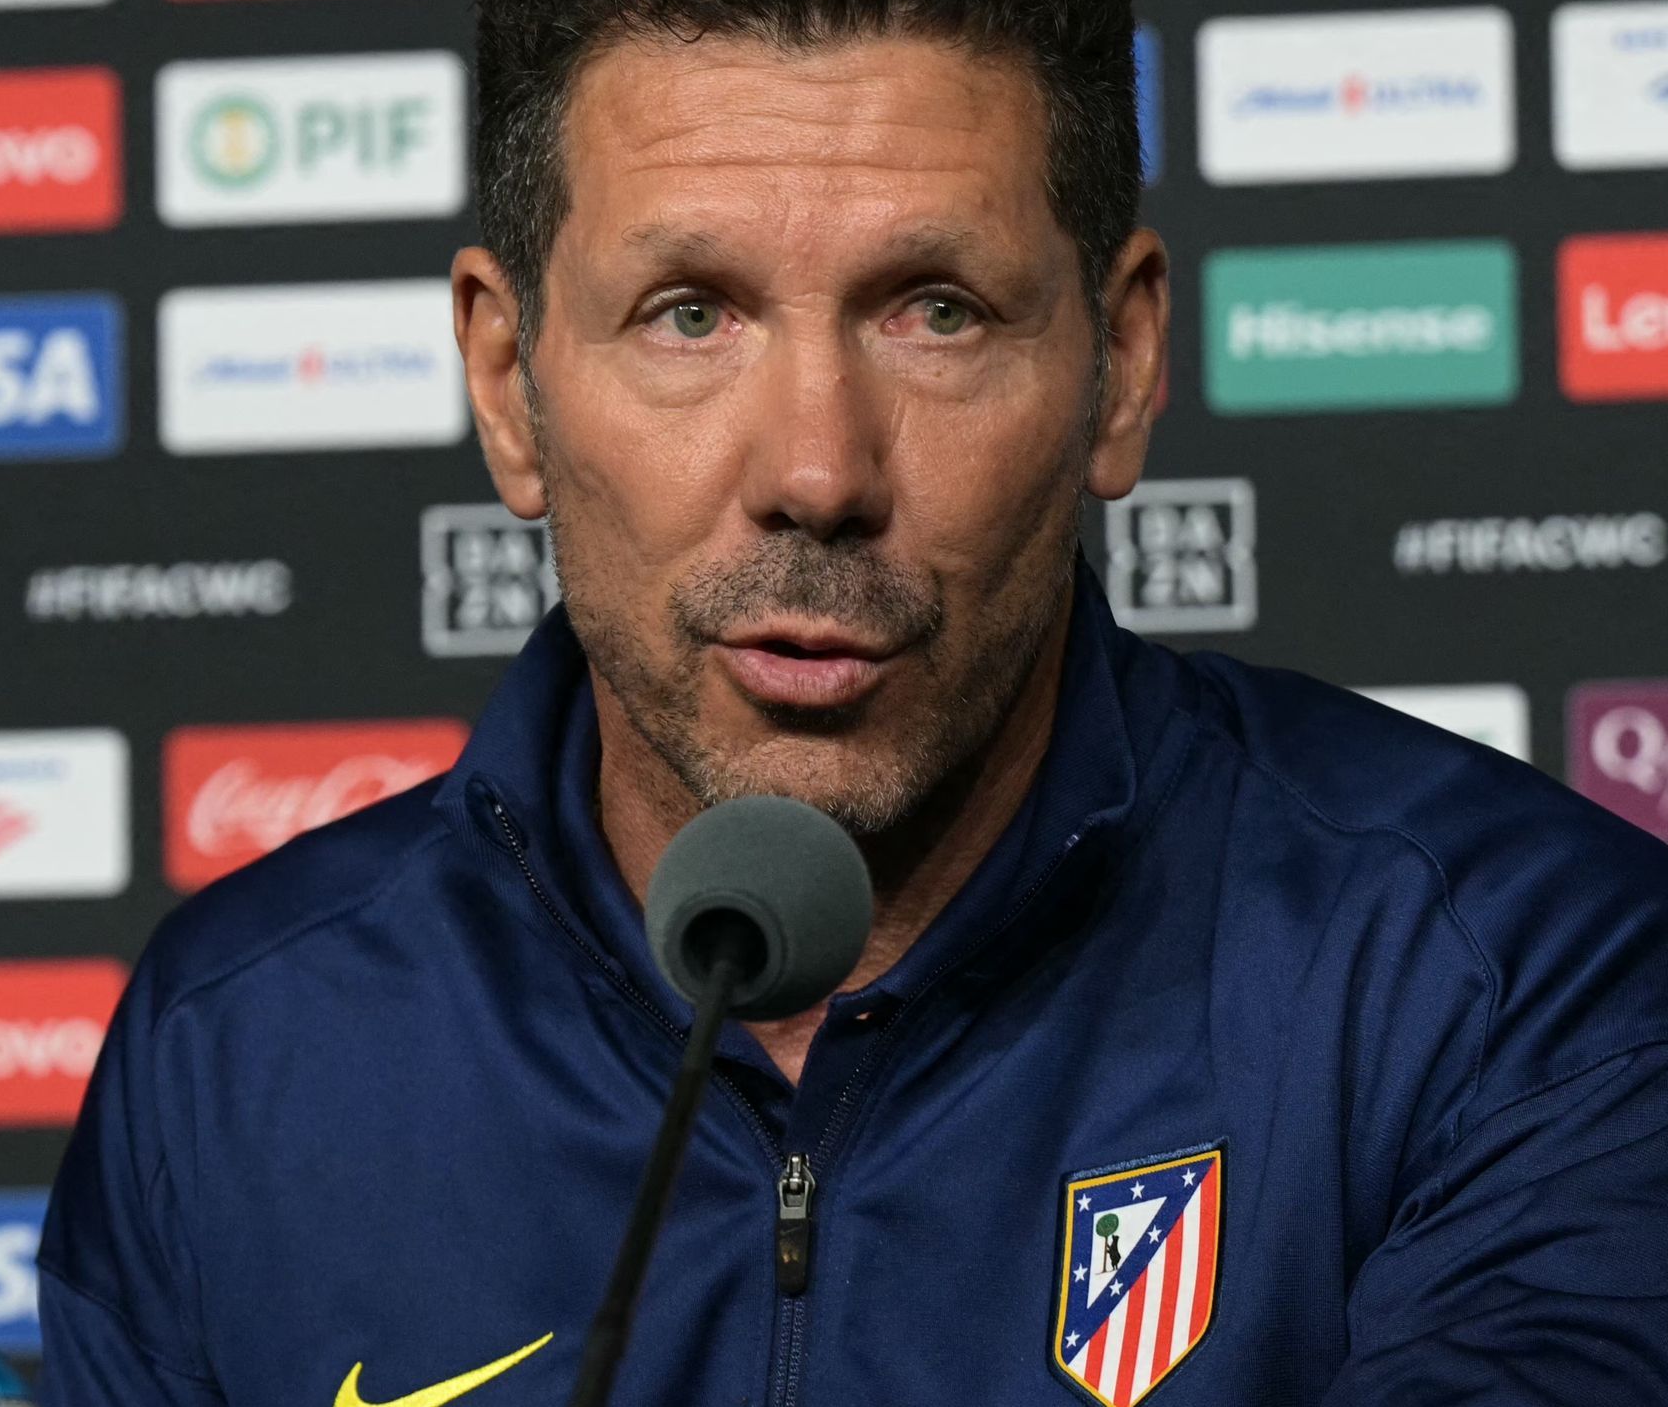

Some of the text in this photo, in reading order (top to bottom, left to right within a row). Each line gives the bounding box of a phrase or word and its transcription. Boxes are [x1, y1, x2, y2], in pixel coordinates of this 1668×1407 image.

[293, 97, 430, 171] PIF
[1227, 305, 1493, 357] Hisense
[1396, 515, 1662, 568] #FIFACWC
